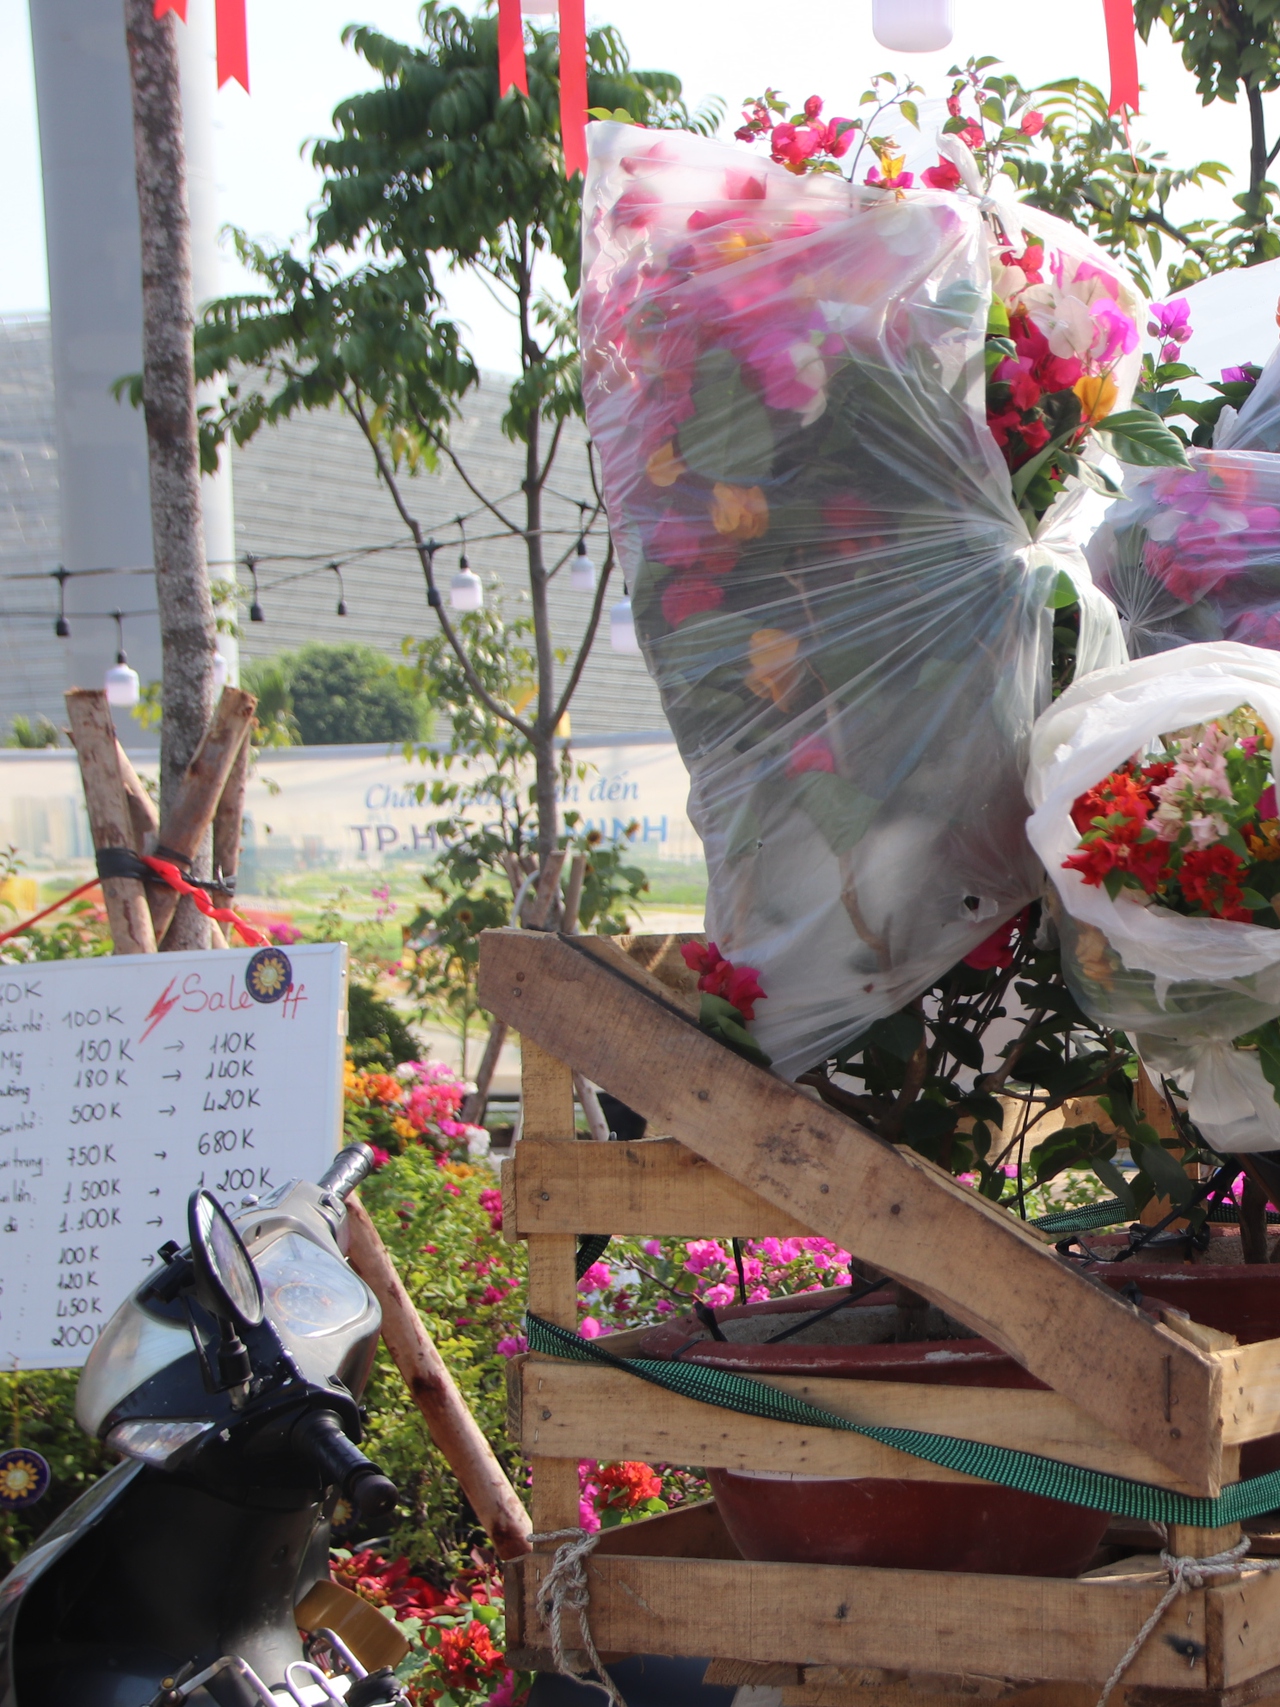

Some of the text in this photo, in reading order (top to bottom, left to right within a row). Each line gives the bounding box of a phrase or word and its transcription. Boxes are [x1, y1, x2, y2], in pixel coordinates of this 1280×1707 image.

[588, 770, 639, 803] đến
[182, 973, 254, 1013] Sale
[282, 982, 308, 1019] ff
[61, 1005, 124, 1030] 100K
[75, 1037, 134, 1063] 150K
[209, 1031, 256, 1054] 110K
[74, 1068, 129, 1089] 180K
[69, 1101, 122, 1124] 500K
[203, 1087, 261, 1112] 420K
[66, 1143, 117, 1167] 750K
[198, 1128, 255, 1156] 680K
[59, 1207, 122, 1234] 1.100K
[58, 1245, 100, 1265] 100K
[56, 1297, 102, 1317] 450K
